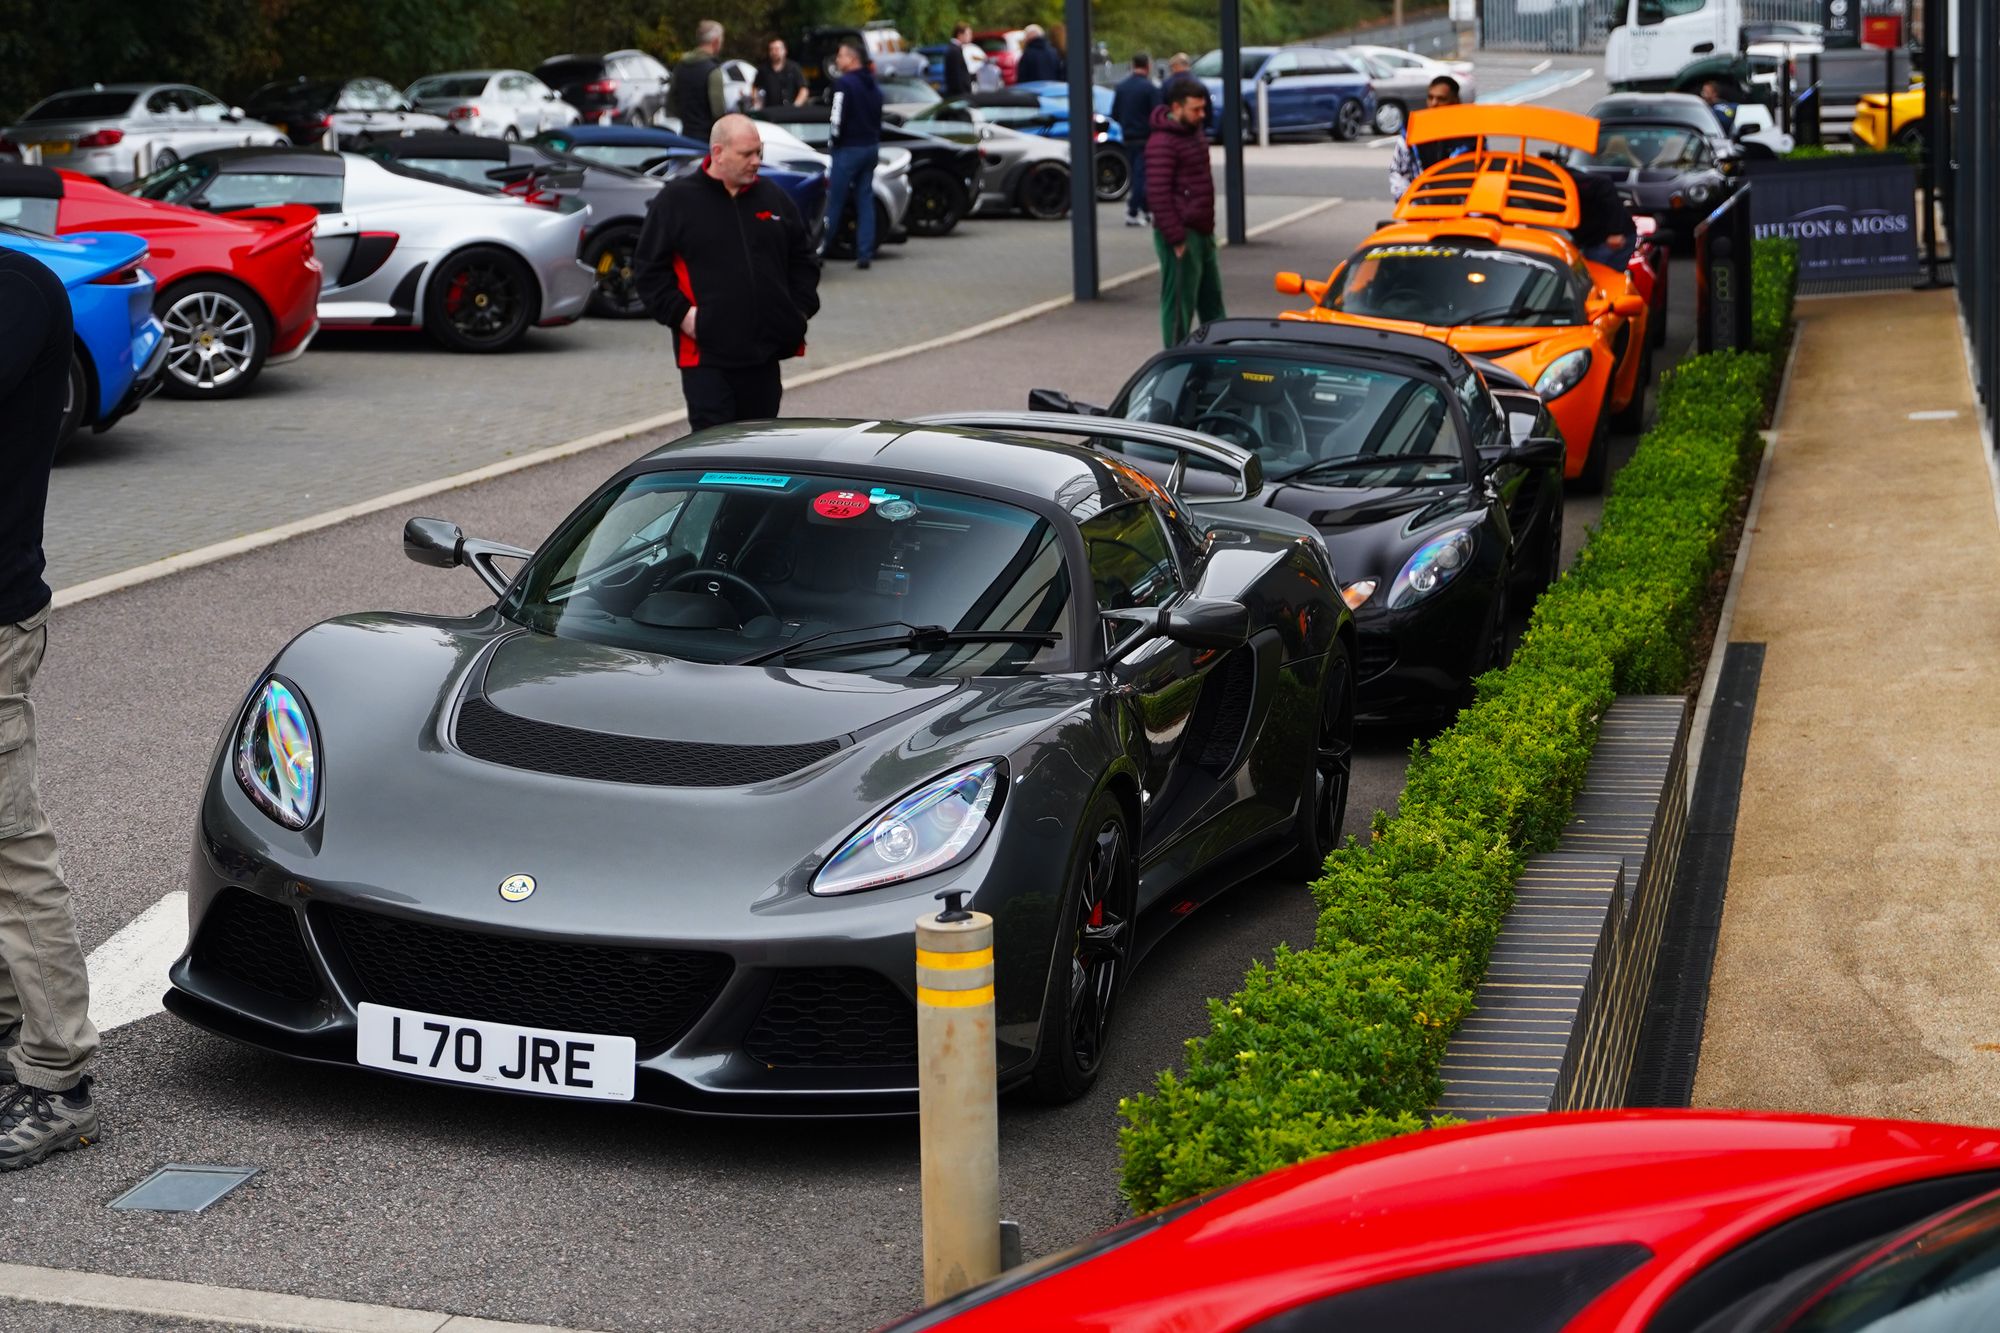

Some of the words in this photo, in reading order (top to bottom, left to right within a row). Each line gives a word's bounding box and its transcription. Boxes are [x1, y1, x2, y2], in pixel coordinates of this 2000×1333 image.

[1754, 218, 1831, 240] HILTON
[1834, 219, 1847, 235] &
[1852, 214, 1908, 235] MOSS
[838, 491, 854, 499] 22
[505, 884, 529, 893] LOTUS
[392, 1016, 482, 1074] L70
[498, 1035, 595, 1089] JRE
